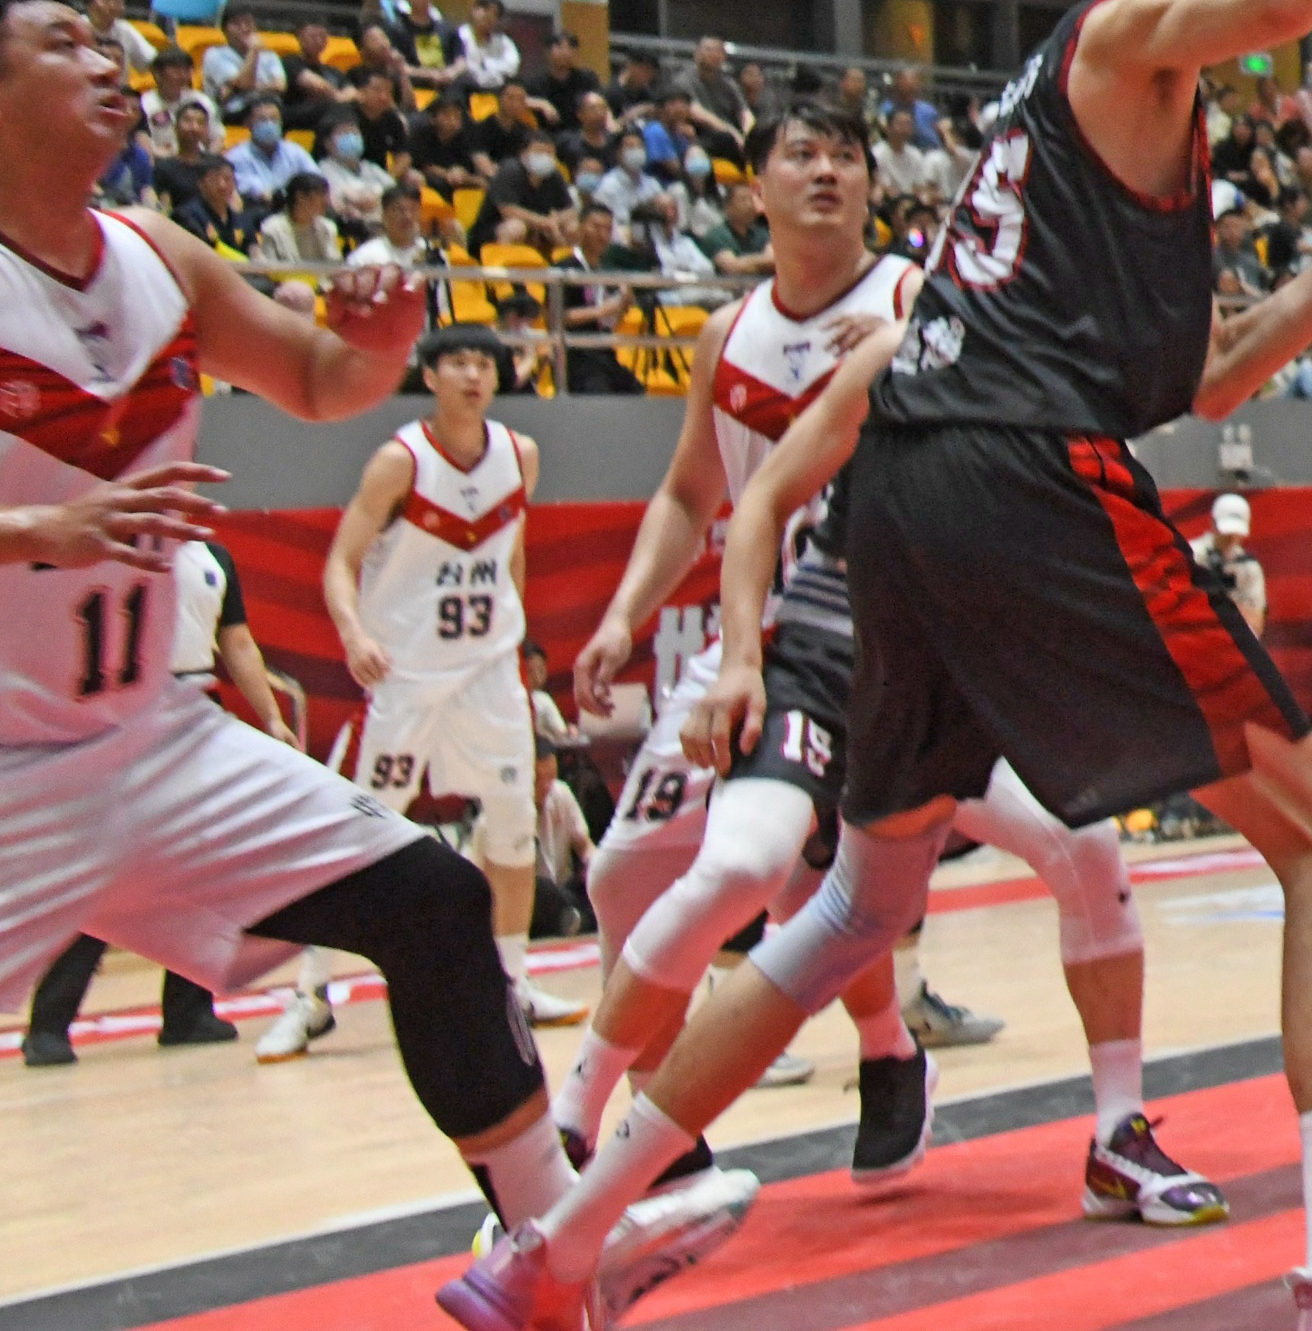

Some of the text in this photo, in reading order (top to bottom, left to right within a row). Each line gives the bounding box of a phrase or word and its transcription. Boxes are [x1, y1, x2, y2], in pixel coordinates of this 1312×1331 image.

[78, 583, 148, 696] 11
[437, 594, 492, 640] 93
[371, 755, 414, 789] 93
[623, 769, 688, 820] 19
